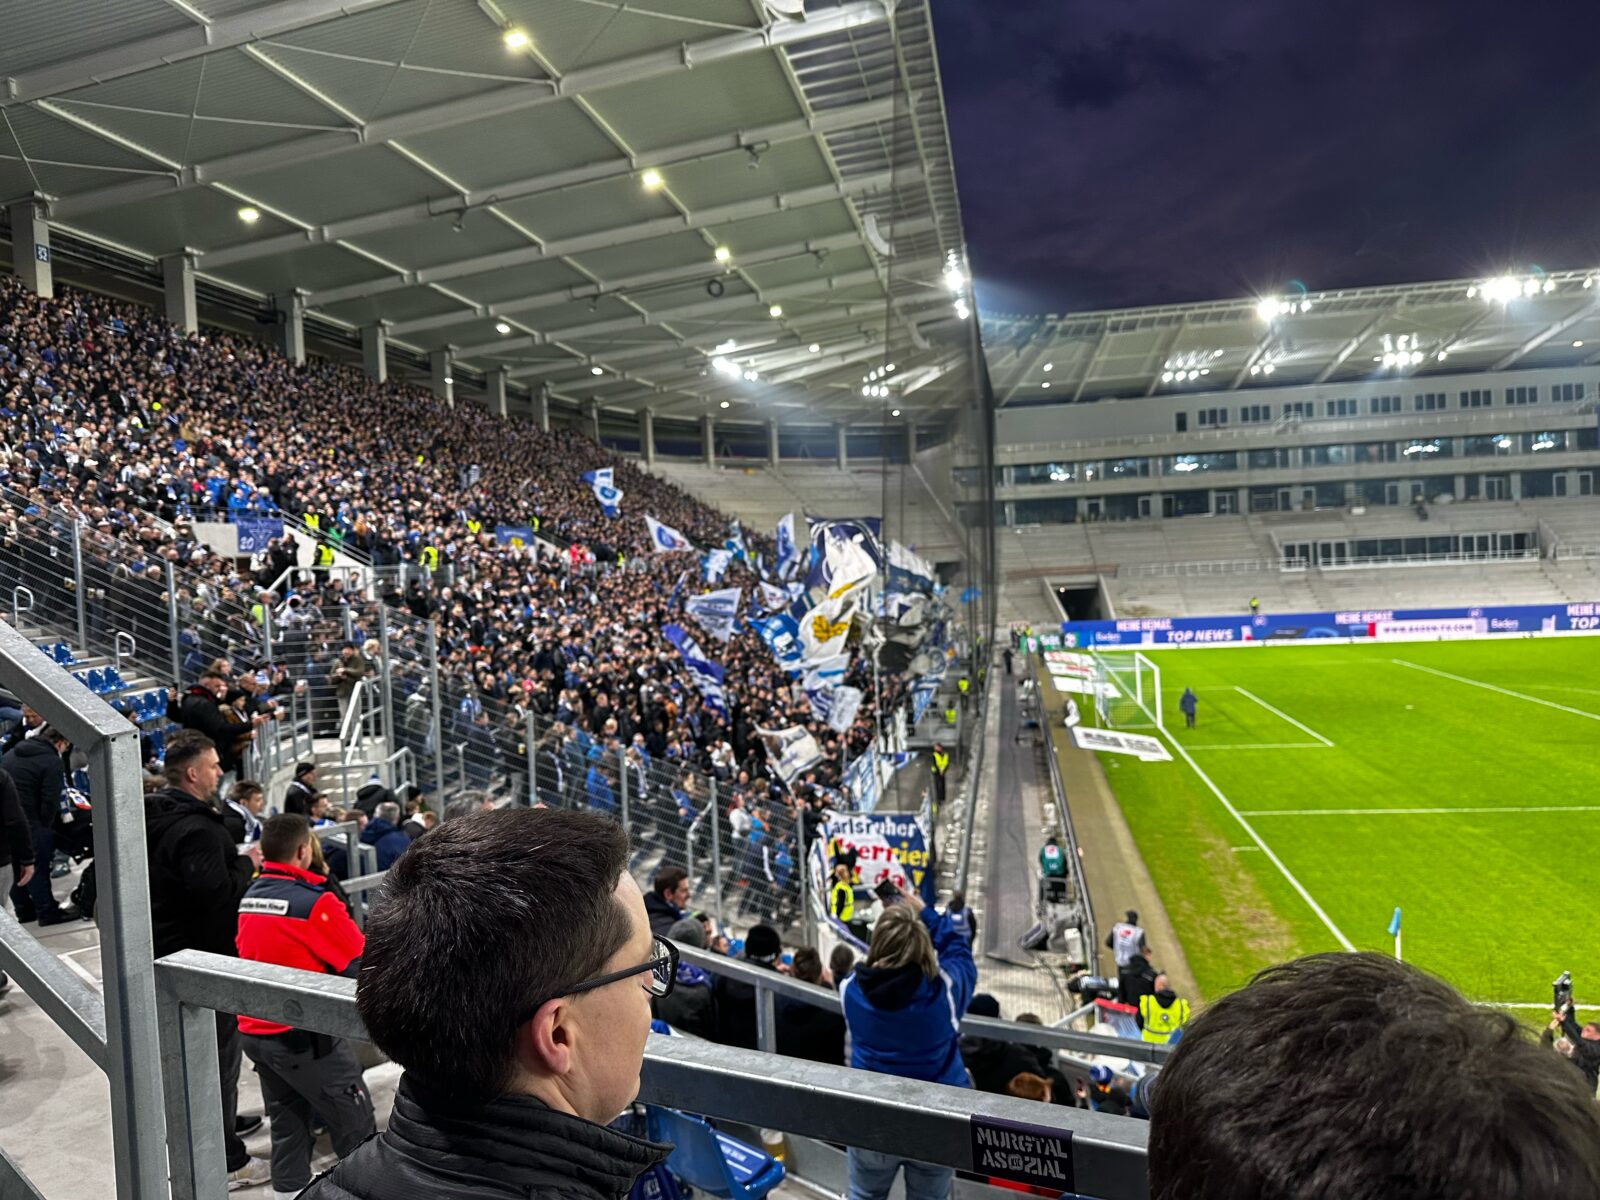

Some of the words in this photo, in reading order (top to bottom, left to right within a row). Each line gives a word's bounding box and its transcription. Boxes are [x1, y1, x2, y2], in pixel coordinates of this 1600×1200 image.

[1570, 616, 1600, 630] TOP
[1166, 629, 1194, 643] TOP
[1194, 628, 1234, 642] NEWS
[977, 1127, 1068, 1159] MURGTAL
